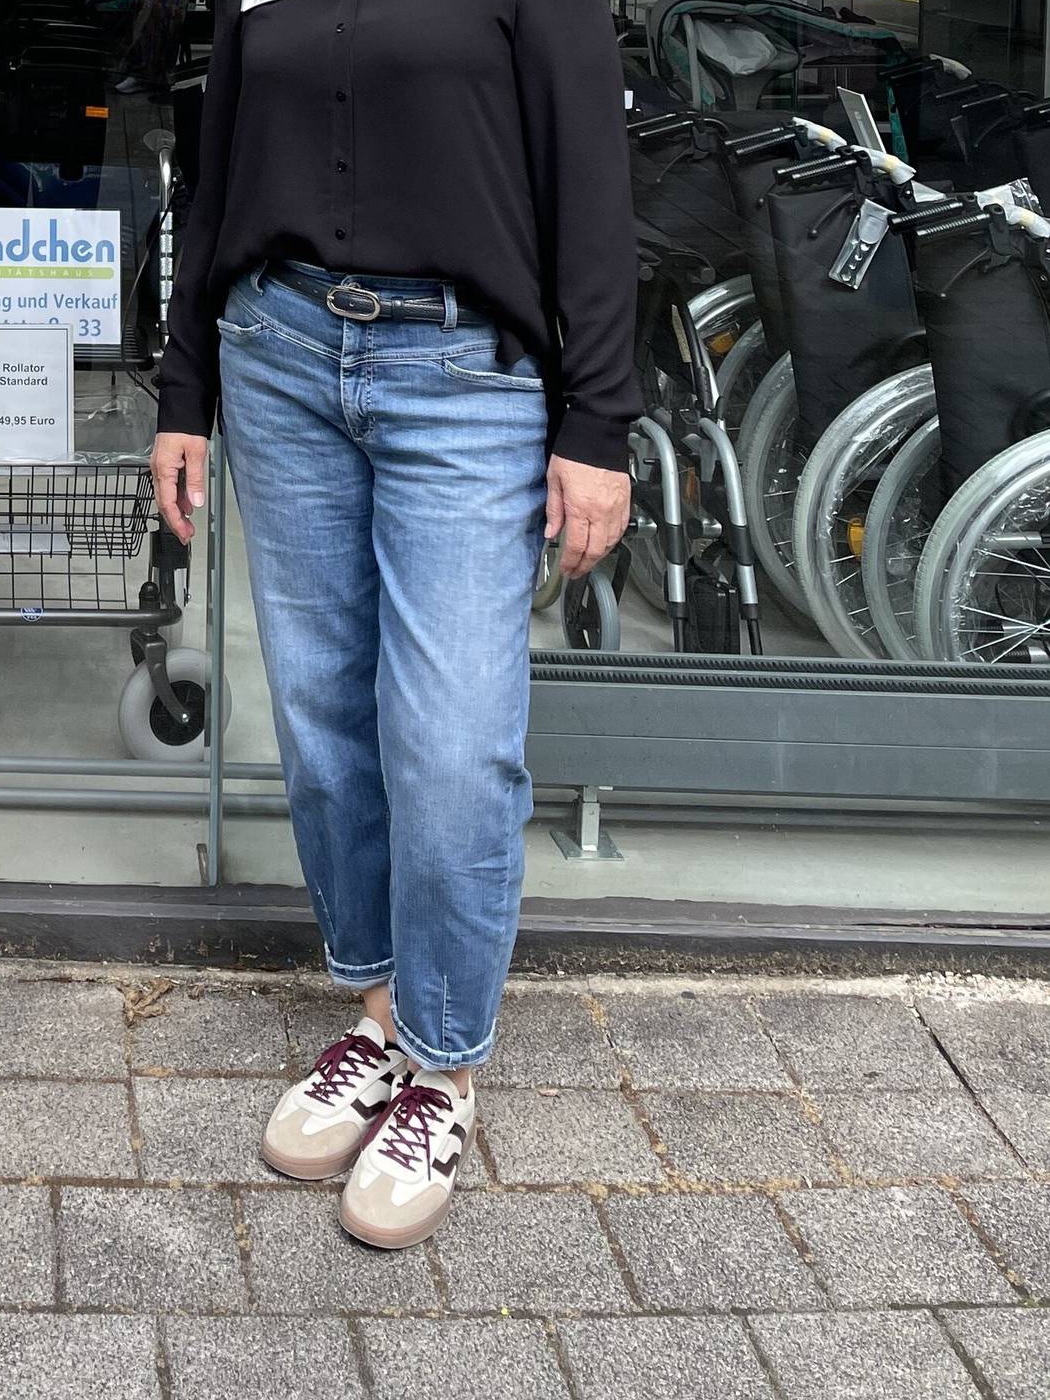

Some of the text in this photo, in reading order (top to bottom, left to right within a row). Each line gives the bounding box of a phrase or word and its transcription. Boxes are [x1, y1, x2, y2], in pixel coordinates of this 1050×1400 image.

[17, 293, 48, 309] und
[53, 293, 118, 310] Verkauf
[78, 319, 101, 336] 33
[2, 363, 45, 373] Rollator
[0, 376, 48, 386] Standard
[30, 416, 55, 426] Euro
